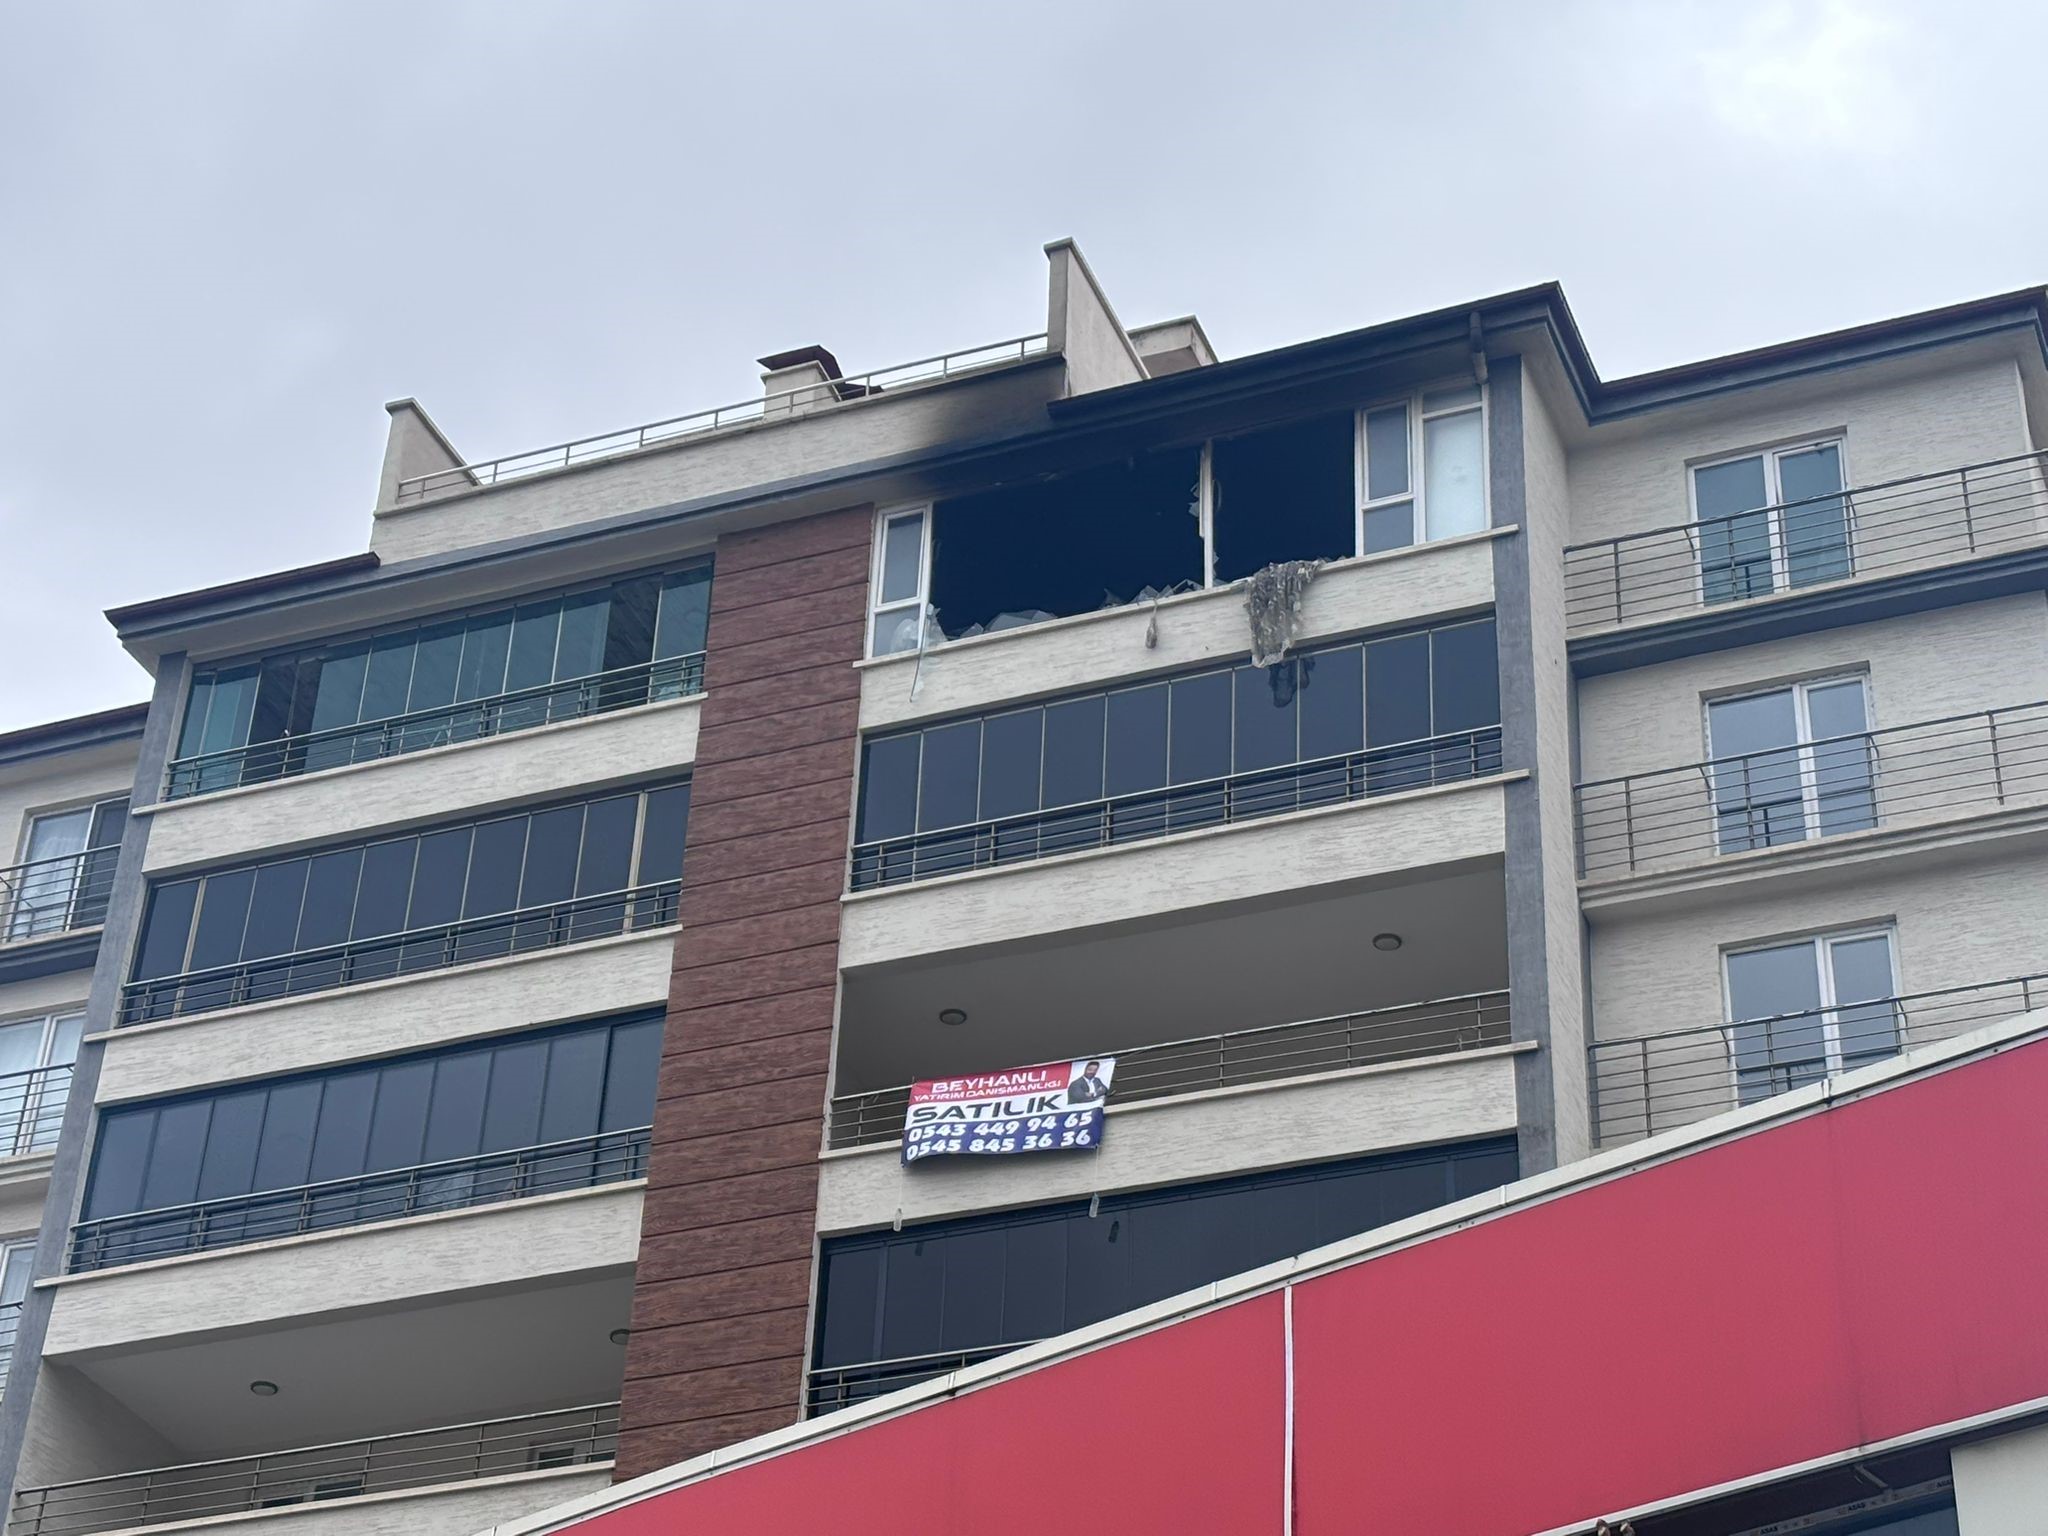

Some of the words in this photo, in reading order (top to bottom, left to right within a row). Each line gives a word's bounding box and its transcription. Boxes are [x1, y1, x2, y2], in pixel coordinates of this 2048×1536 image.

[913, 1091, 965, 1103] YATIRIM
[931, 1070, 1047, 1094] BEYHANLI
[911, 1094, 1064, 1124] SATILIK
[908, 1124, 966, 1143] 0543
[974, 1121, 1020, 1136] 449
[1027, 1114, 1057, 1131] 94
[1064, 1110, 1093, 1127] 65
[906, 1138, 961, 1161] 0545
[969, 1137, 1015, 1153] 845
[1022, 1133, 1053, 1149] 36
[1060, 1129, 1091, 1147] 36
